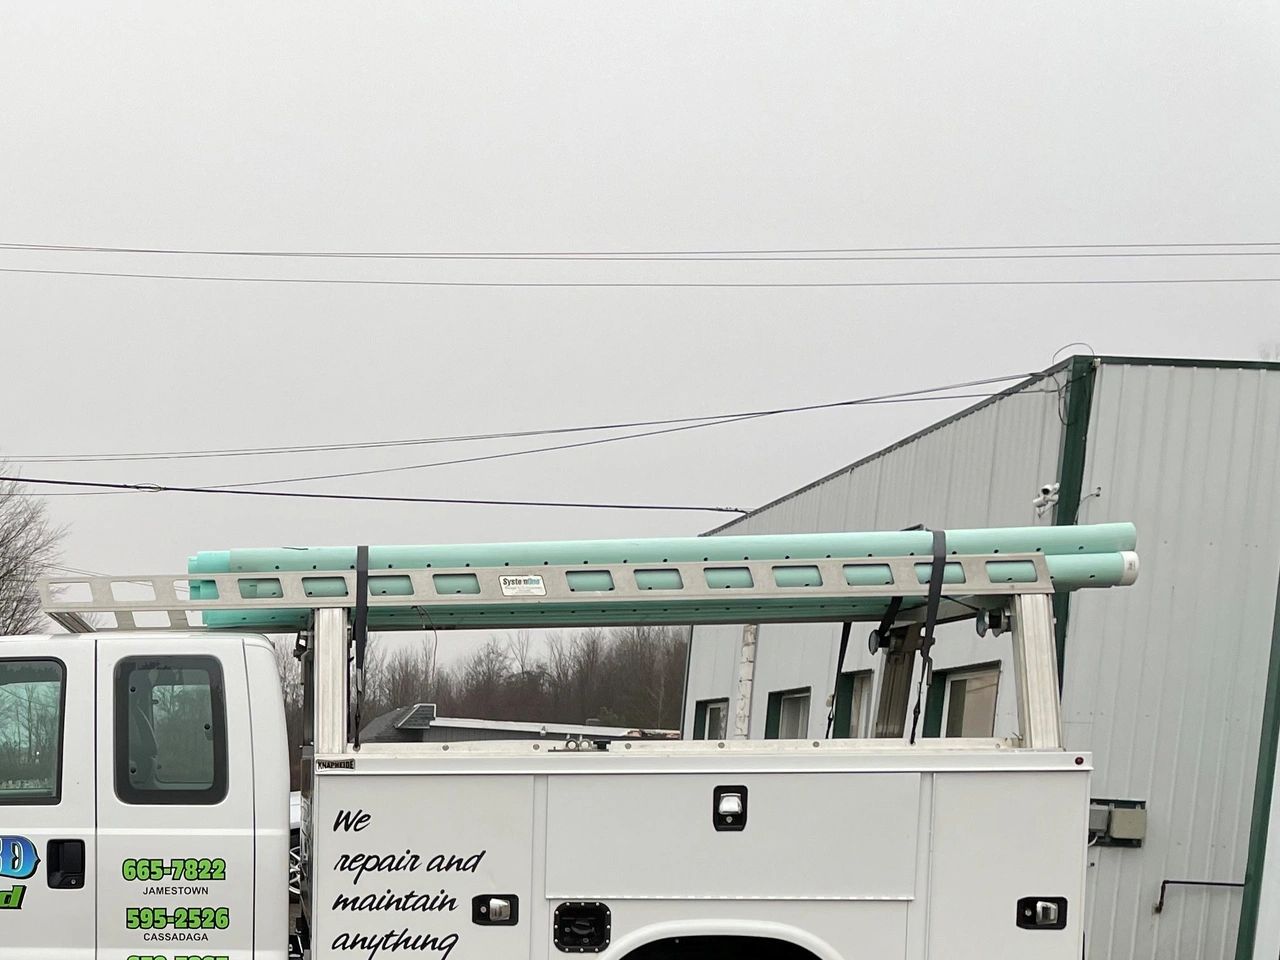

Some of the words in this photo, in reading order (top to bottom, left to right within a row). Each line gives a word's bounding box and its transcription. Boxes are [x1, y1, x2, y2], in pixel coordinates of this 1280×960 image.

[333, 809, 371, 832] We
[122, 858, 226, 881] 665-7822
[334, 849, 422, 885] repair
[426, 850, 486, 872] and
[143, 887, 209, 895] JAMESTOWN
[332, 889, 459, 911] maintain
[126, 907, 230, 929] 595-2526
[143, 933, 209, 941] CASSADAGA
